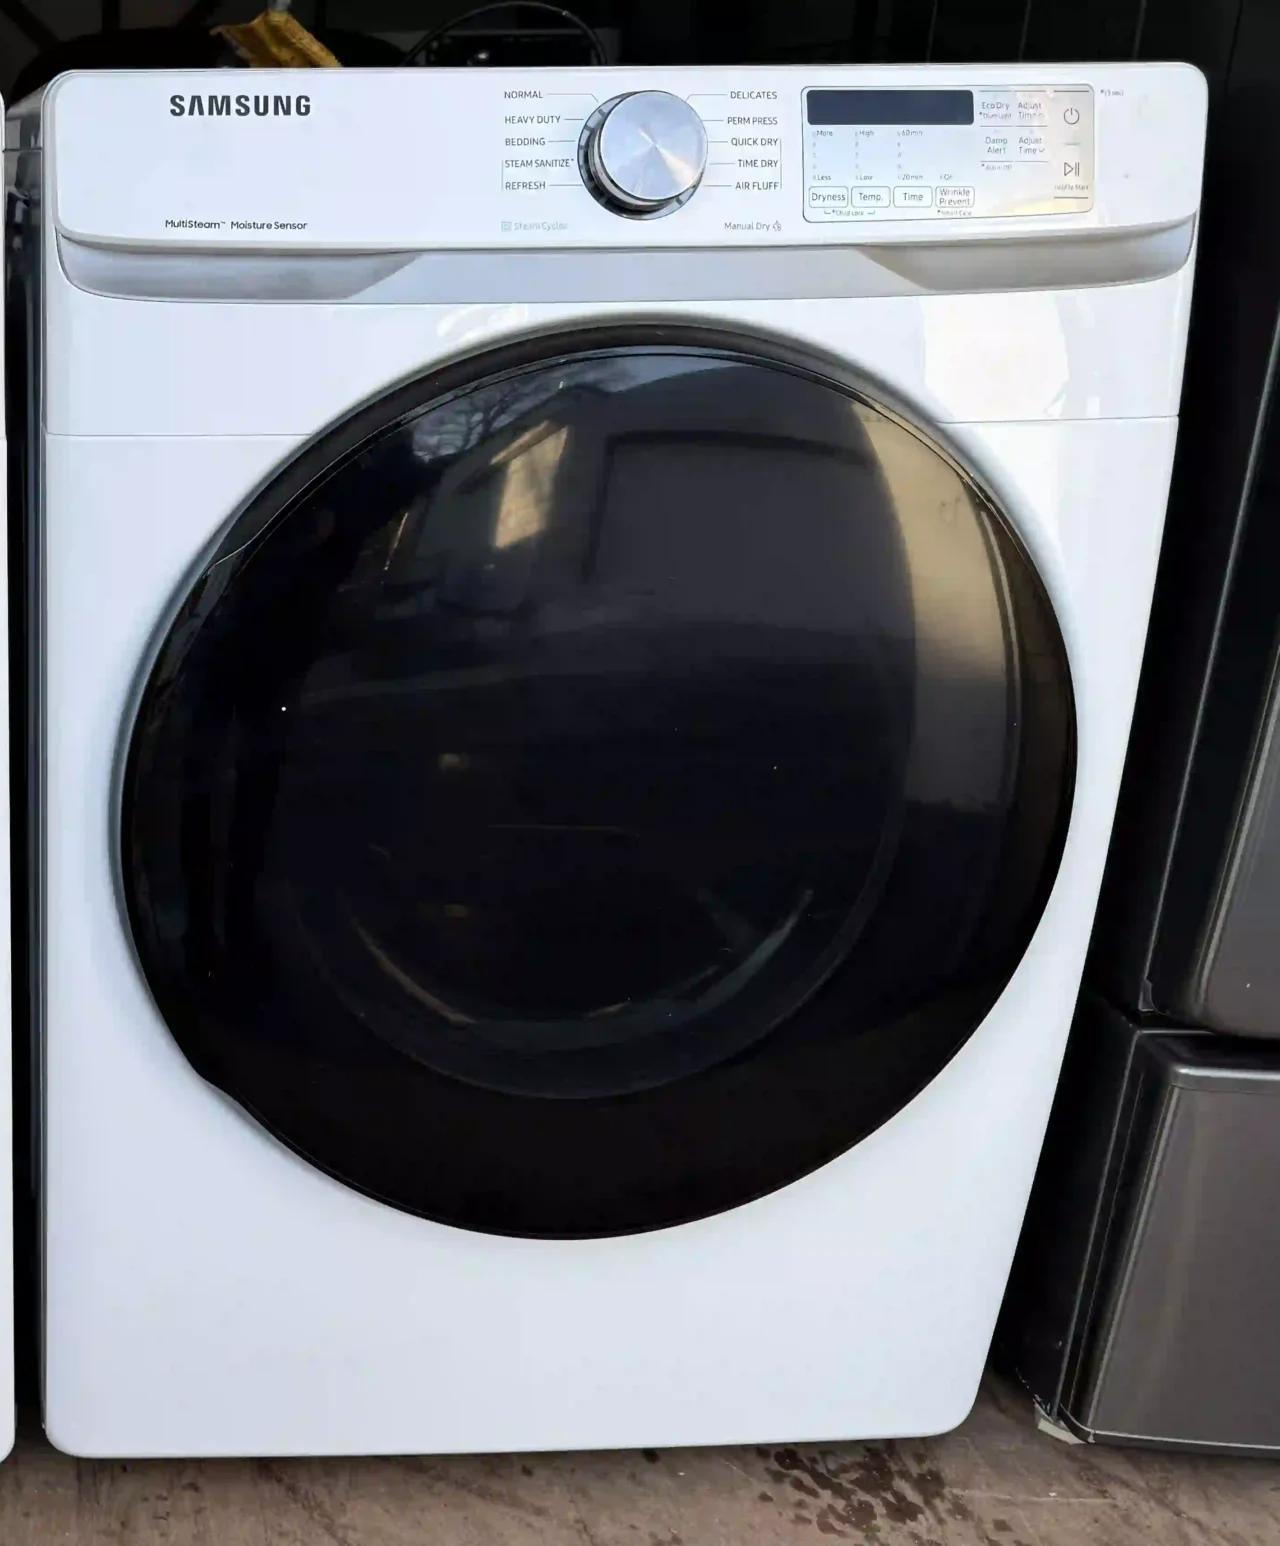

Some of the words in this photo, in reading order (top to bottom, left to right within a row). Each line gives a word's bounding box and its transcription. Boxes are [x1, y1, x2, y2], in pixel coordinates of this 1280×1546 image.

[503, 90, 544, 99] NORMAL
[730, 91, 778, 100] DELICATES
[169, 94, 311, 117] SAMSUNG
[981, 101, 995, 109] Eco
[1017, 101, 1042, 110] Adjust
[504, 115, 535, 125] HEAVY
[536, 115, 561, 124] DUTY
[727, 116, 751, 126] PERM
[752, 116, 778, 126] PRESS
[505, 137, 546, 147] BEDDING
[730, 137, 758, 147] QUICK
[760, 137, 779, 147] DRY
[985, 136, 1008, 145] Damp
[1018, 136, 1043, 145] Adjust
[986, 146, 1007, 154] Alert
[1018, 146, 1037, 154] Time
[505, 159, 533, 168] STEAM
[738, 159, 759, 168] TIME
[760, 159, 779, 168] DRY
[505, 181, 546, 190] REFRESH
[735, 181, 749, 190] AIR
[751, 181, 779, 190] FLUFF
[858, 192, 884, 202] Temp.
[902, 192, 924, 202] Time
[939, 188, 970, 197] Wrinkle
[811, 192, 846, 203] Dryness
[939, 197, 970, 206] Prevent
[230, 220, 273, 230] Moisture
[273, 221, 308, 231] Sensor
[724, 221, 754, 231] Manual
[755, 221, 771, 232] Dry
